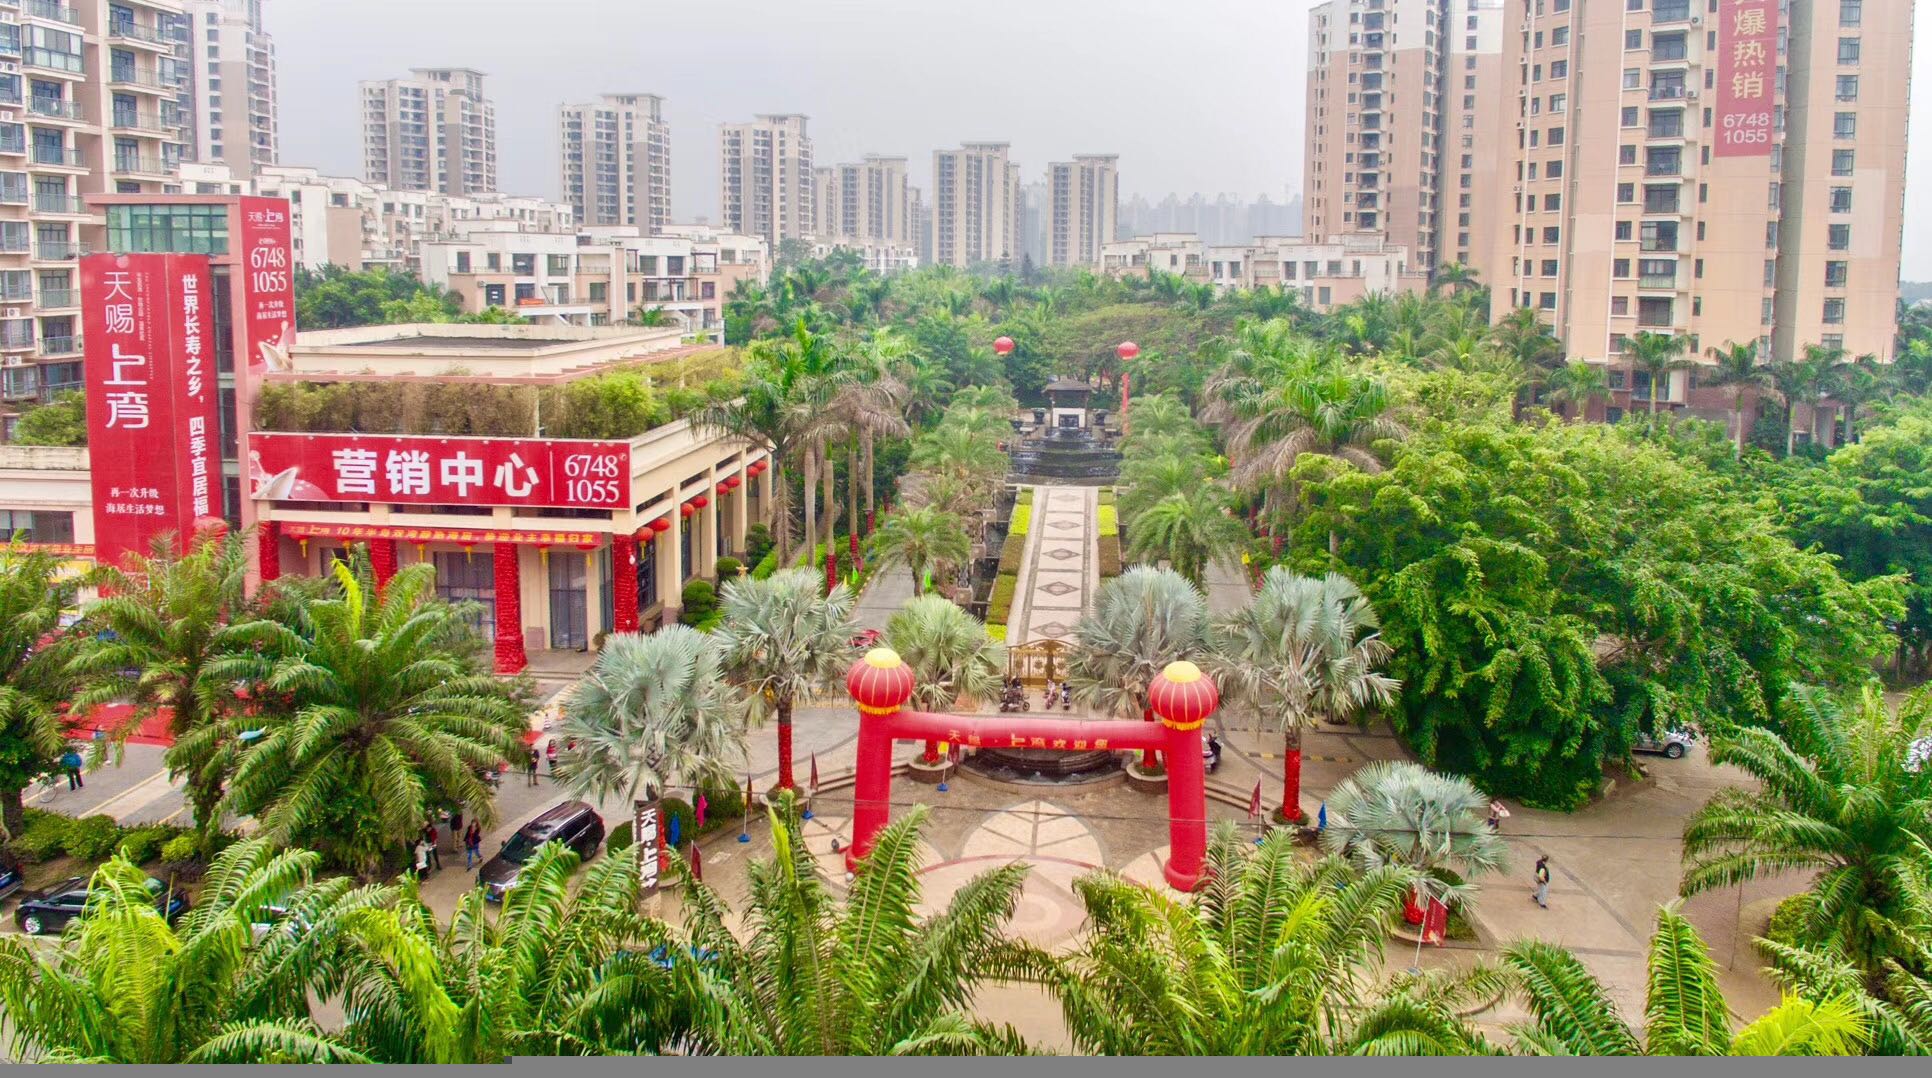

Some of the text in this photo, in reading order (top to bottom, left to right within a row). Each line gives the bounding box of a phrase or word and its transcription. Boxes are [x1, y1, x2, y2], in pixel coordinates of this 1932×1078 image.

[1732, 0, 1766, 99] 爆热销
[1723, 112, 1769, 128] 6748
[1723, 129, 1768, 144] 1055
[251, 247, 286, 268] 6748
[252, 271, 287, 292] 1055
[331, 447, 540, 499] 营销中心
[564, 454, 619, 478] 6748
[110, 487, 160, 499] 再一次升级
[565, 479, 620, 503] 1055
[105, 502, 166, 516] 海居生活梦想
